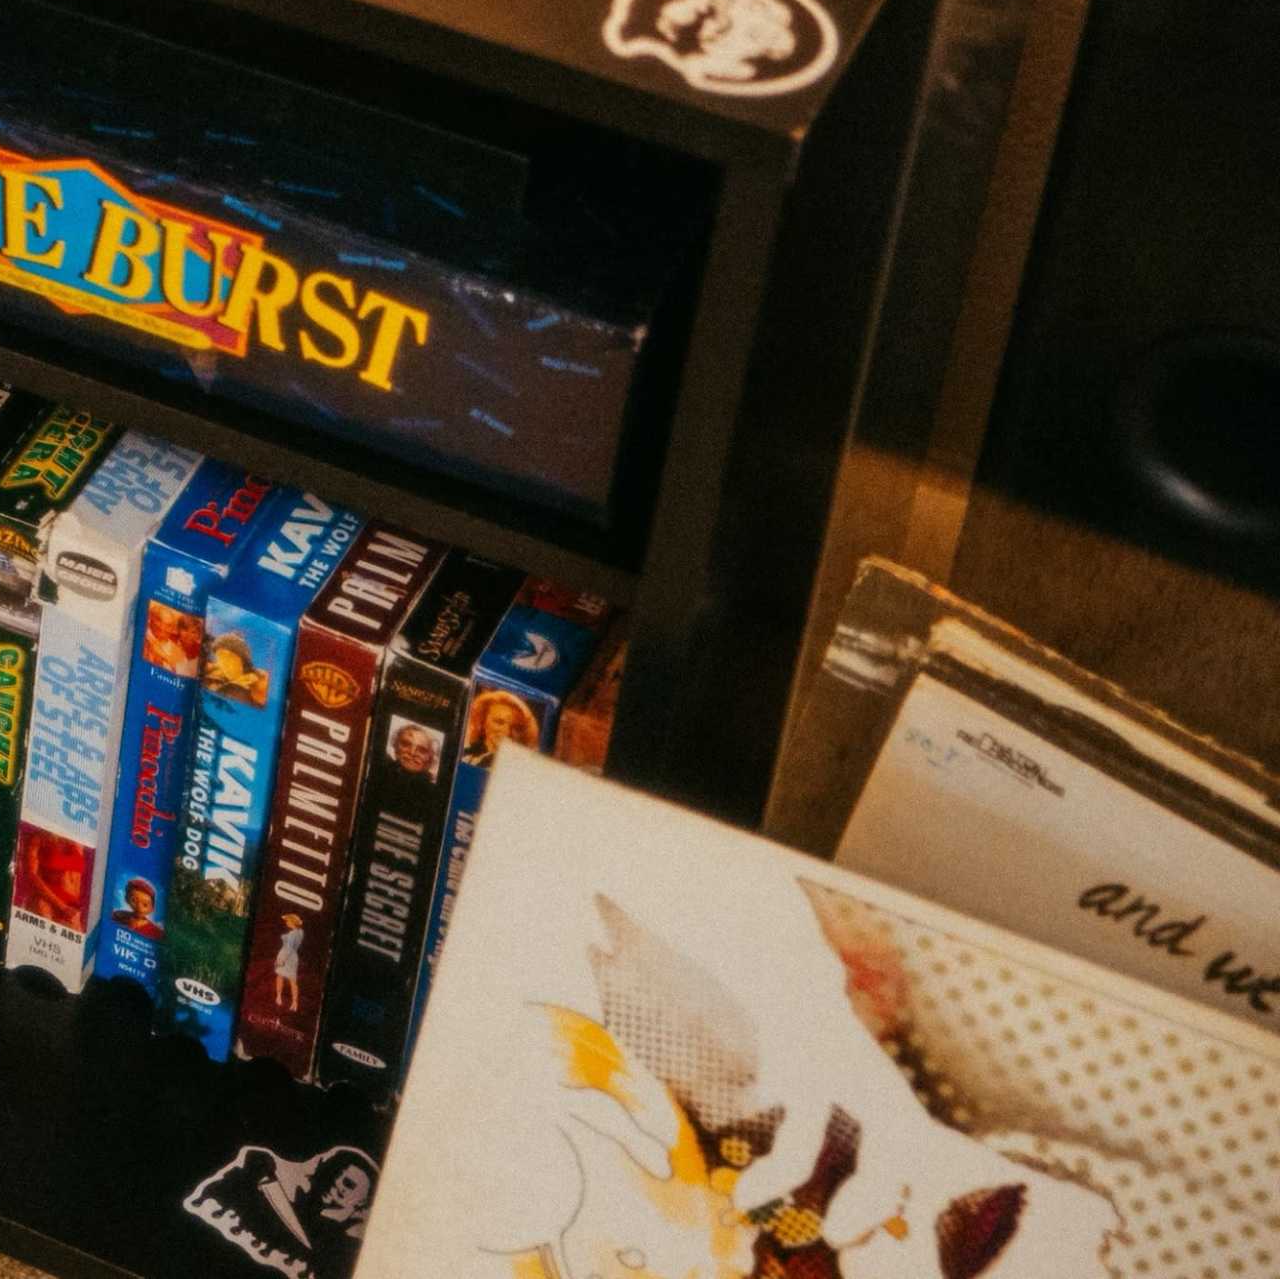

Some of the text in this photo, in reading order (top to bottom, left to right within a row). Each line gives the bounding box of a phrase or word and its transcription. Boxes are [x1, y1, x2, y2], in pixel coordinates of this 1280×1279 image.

[81, 197, 430, 394] BURST
[299, 560, 326, 592] THE
[131, 701, 182, 850] Pinocchio
[183, 725, 217, 872] THE WOLF DOG
[205, 734, 258, 894] KAVIK
[273, 708, 352, 912] PALMETTO
[14, 909, 83, 945] ARMS & ABS
[356, 810, 425, 963] THE SECRET
[1078, 882, 1207, 957] and
[112, 944, 140, 963] VHS
[181, 980, 216, 1003] VHS
[339, 1046, 381, 1067] FAMILY
